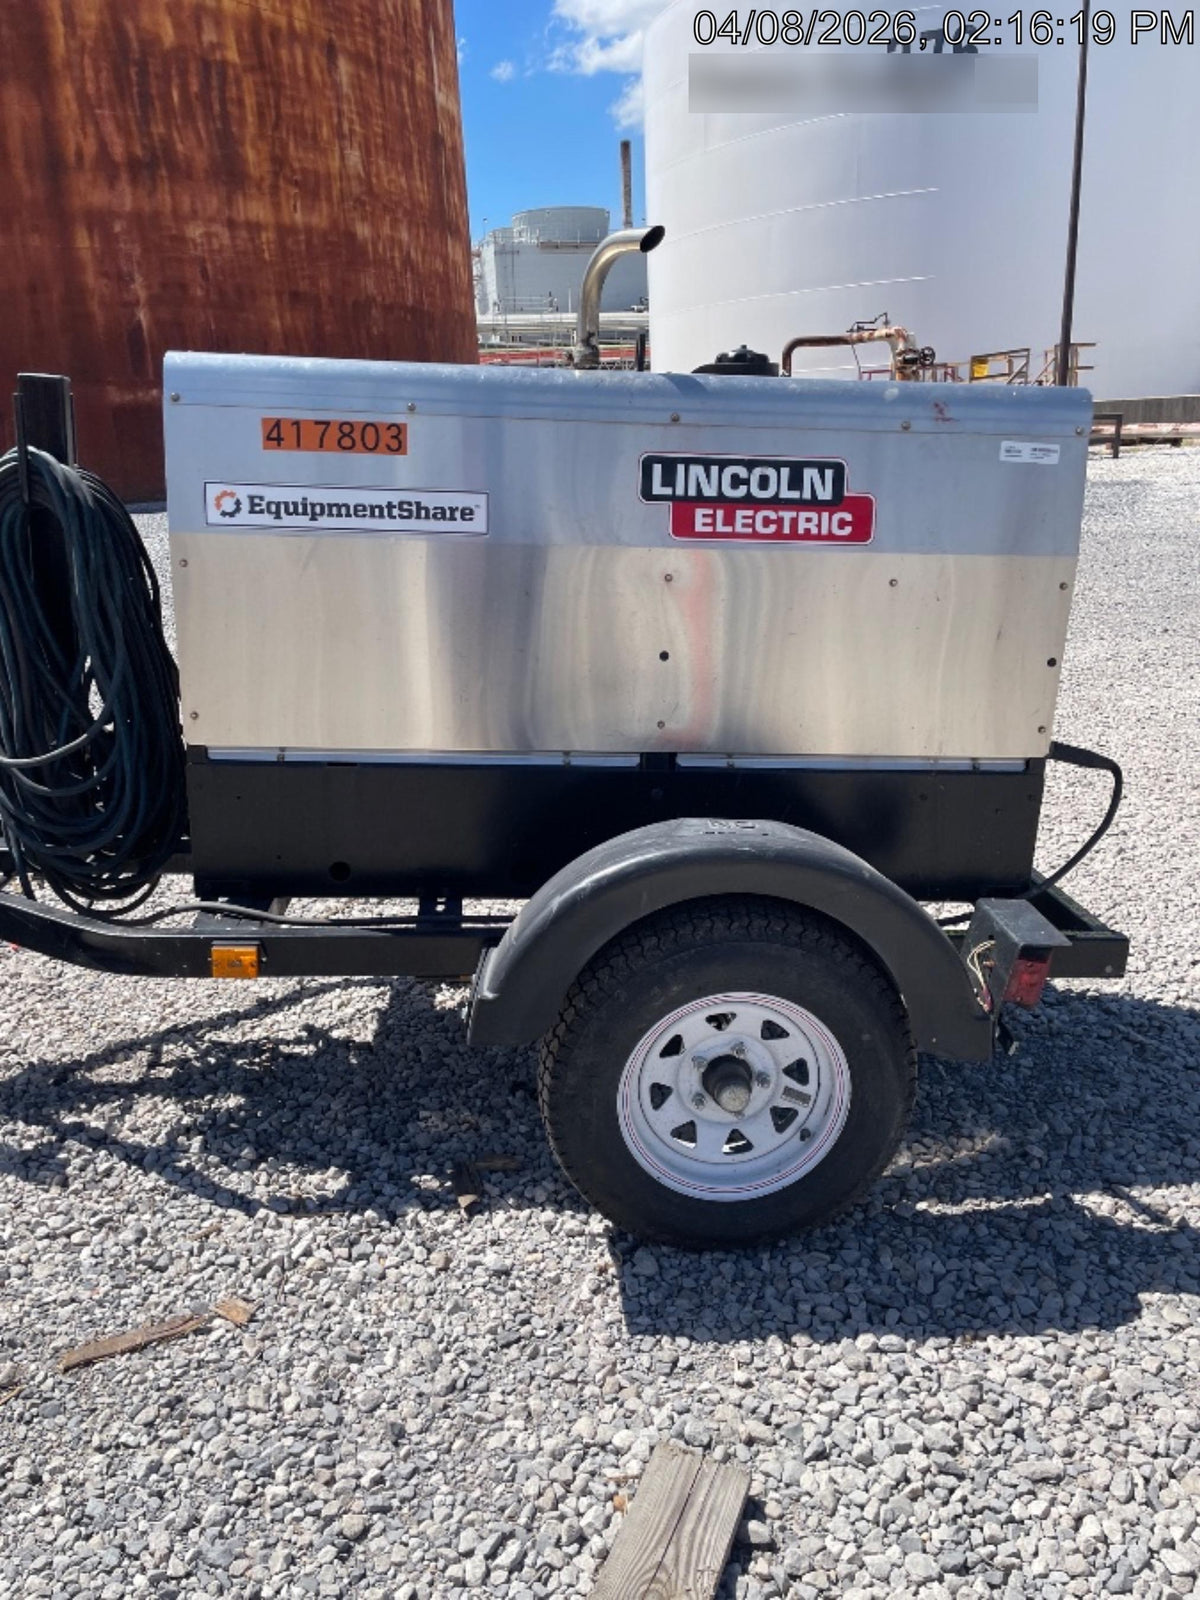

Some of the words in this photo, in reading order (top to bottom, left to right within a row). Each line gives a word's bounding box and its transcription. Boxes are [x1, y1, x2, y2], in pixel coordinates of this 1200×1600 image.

[265, 418, 404, 453] 417803
[651, 463, 835, 501] LINCOLN
[247, 494, 475, 522] EquipmentShare
[694, 507, 854, 536] ELECTRIC
